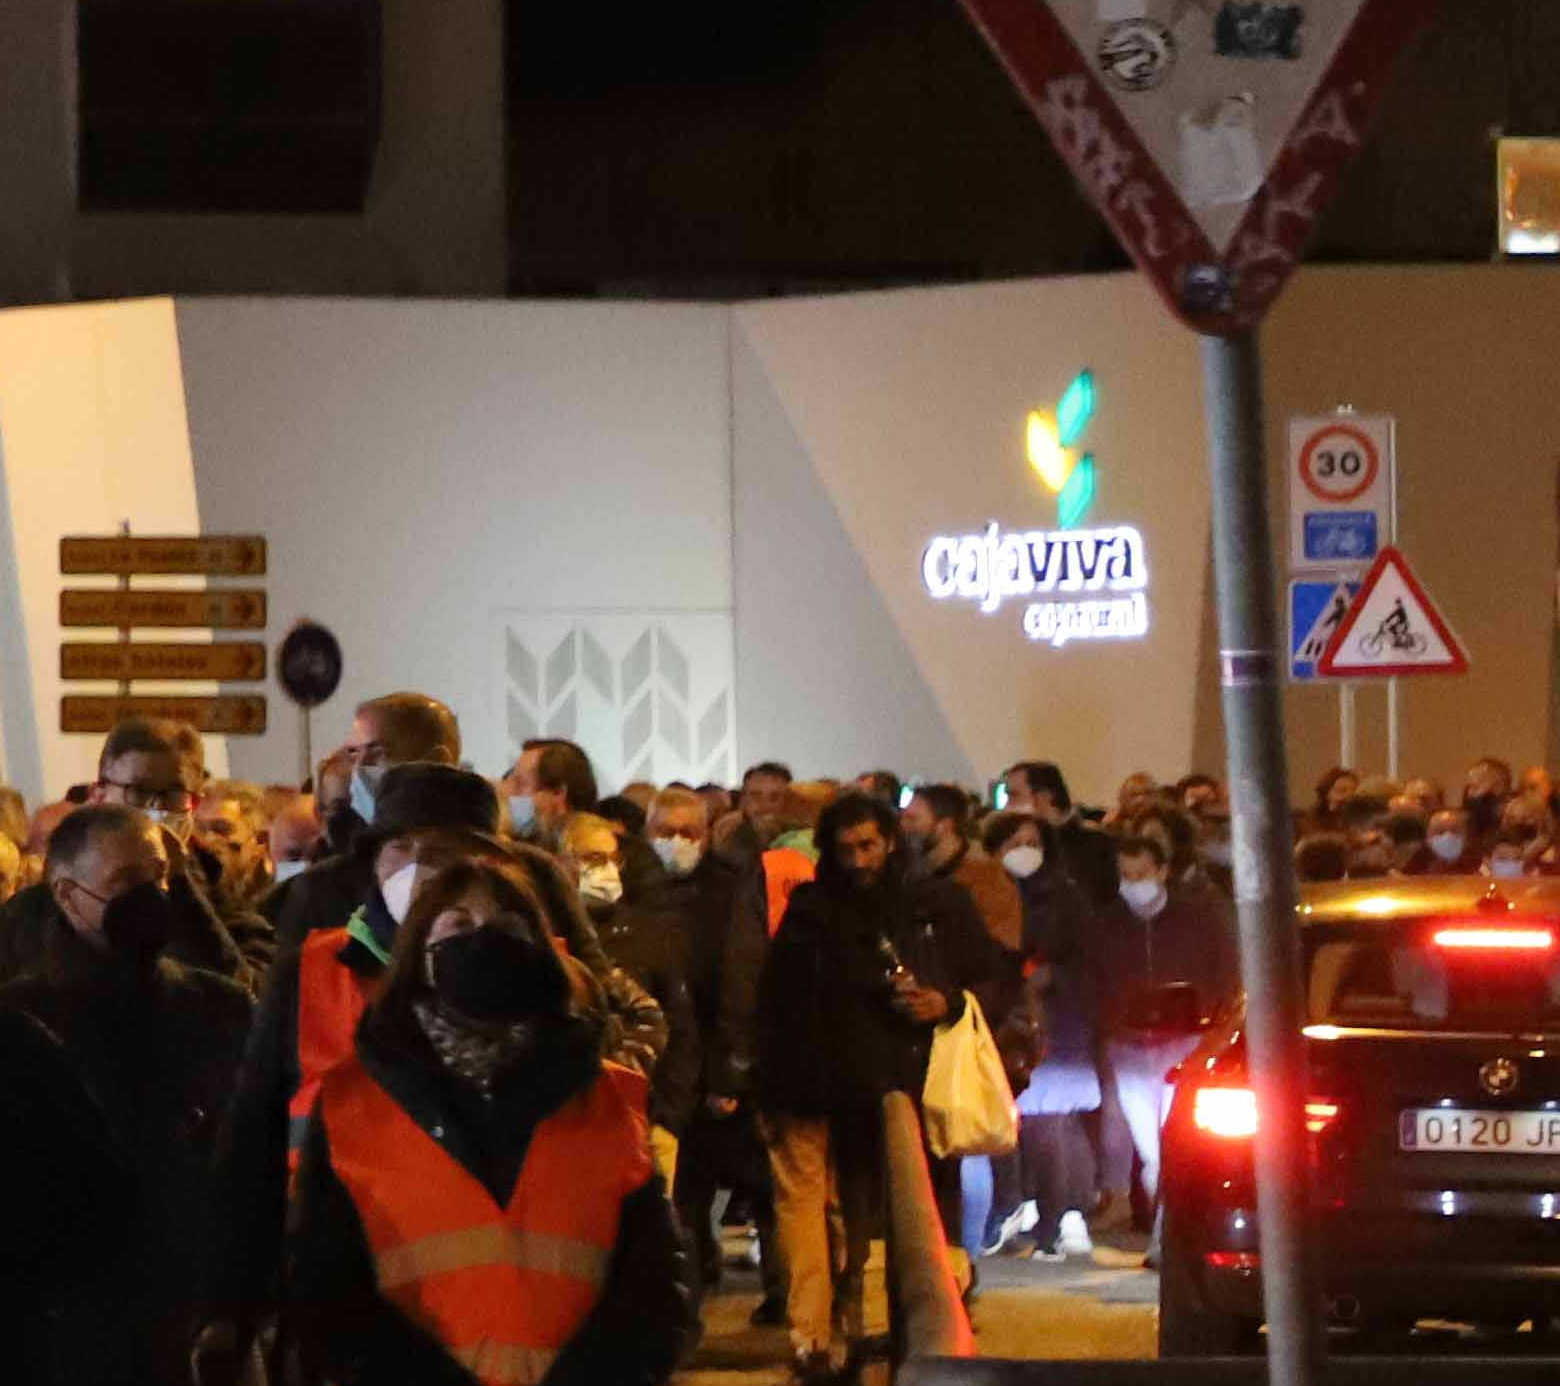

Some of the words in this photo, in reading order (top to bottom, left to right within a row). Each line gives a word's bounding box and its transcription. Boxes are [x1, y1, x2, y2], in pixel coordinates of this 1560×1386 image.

[1317, 450, 1361, 478] 30
[922, 521, 1146, 613] cajaviva
[1426, 1117, 1513, 1146] 0120
